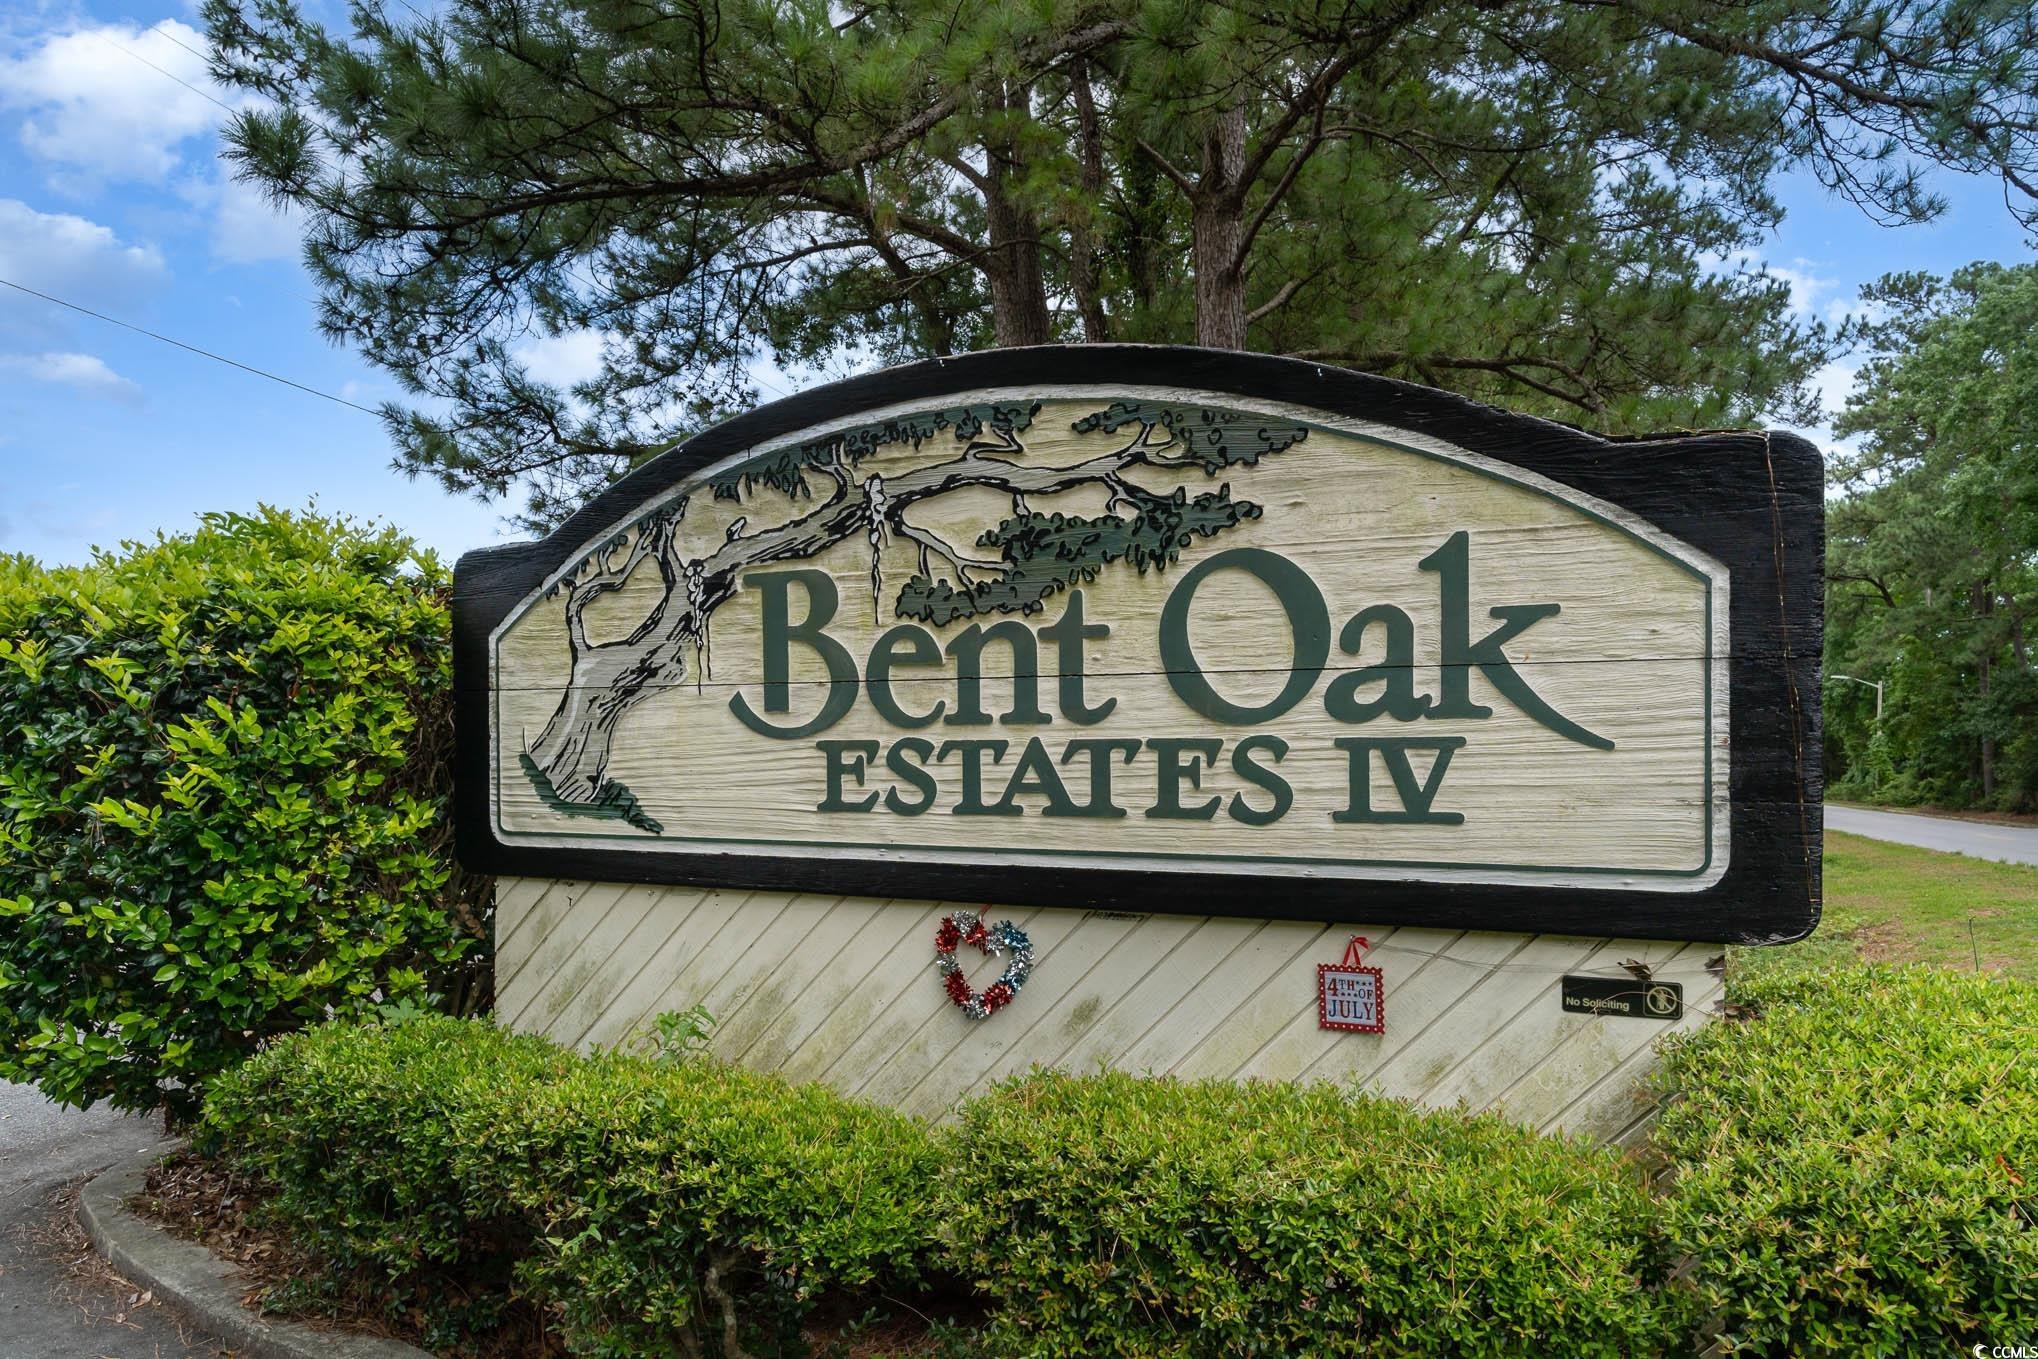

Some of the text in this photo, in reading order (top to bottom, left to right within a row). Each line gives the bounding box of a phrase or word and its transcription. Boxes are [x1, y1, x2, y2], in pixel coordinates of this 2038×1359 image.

[729, 530, 1615, 751] Bent Oak
[815, 736, 1466, 826] ESTATES IV
[1327, 977, 1373, 1000] 4TH OF
[1328, 1000, 1374, 1021] JULY
[1566, 997, 1630, 1012] No Soliciting
